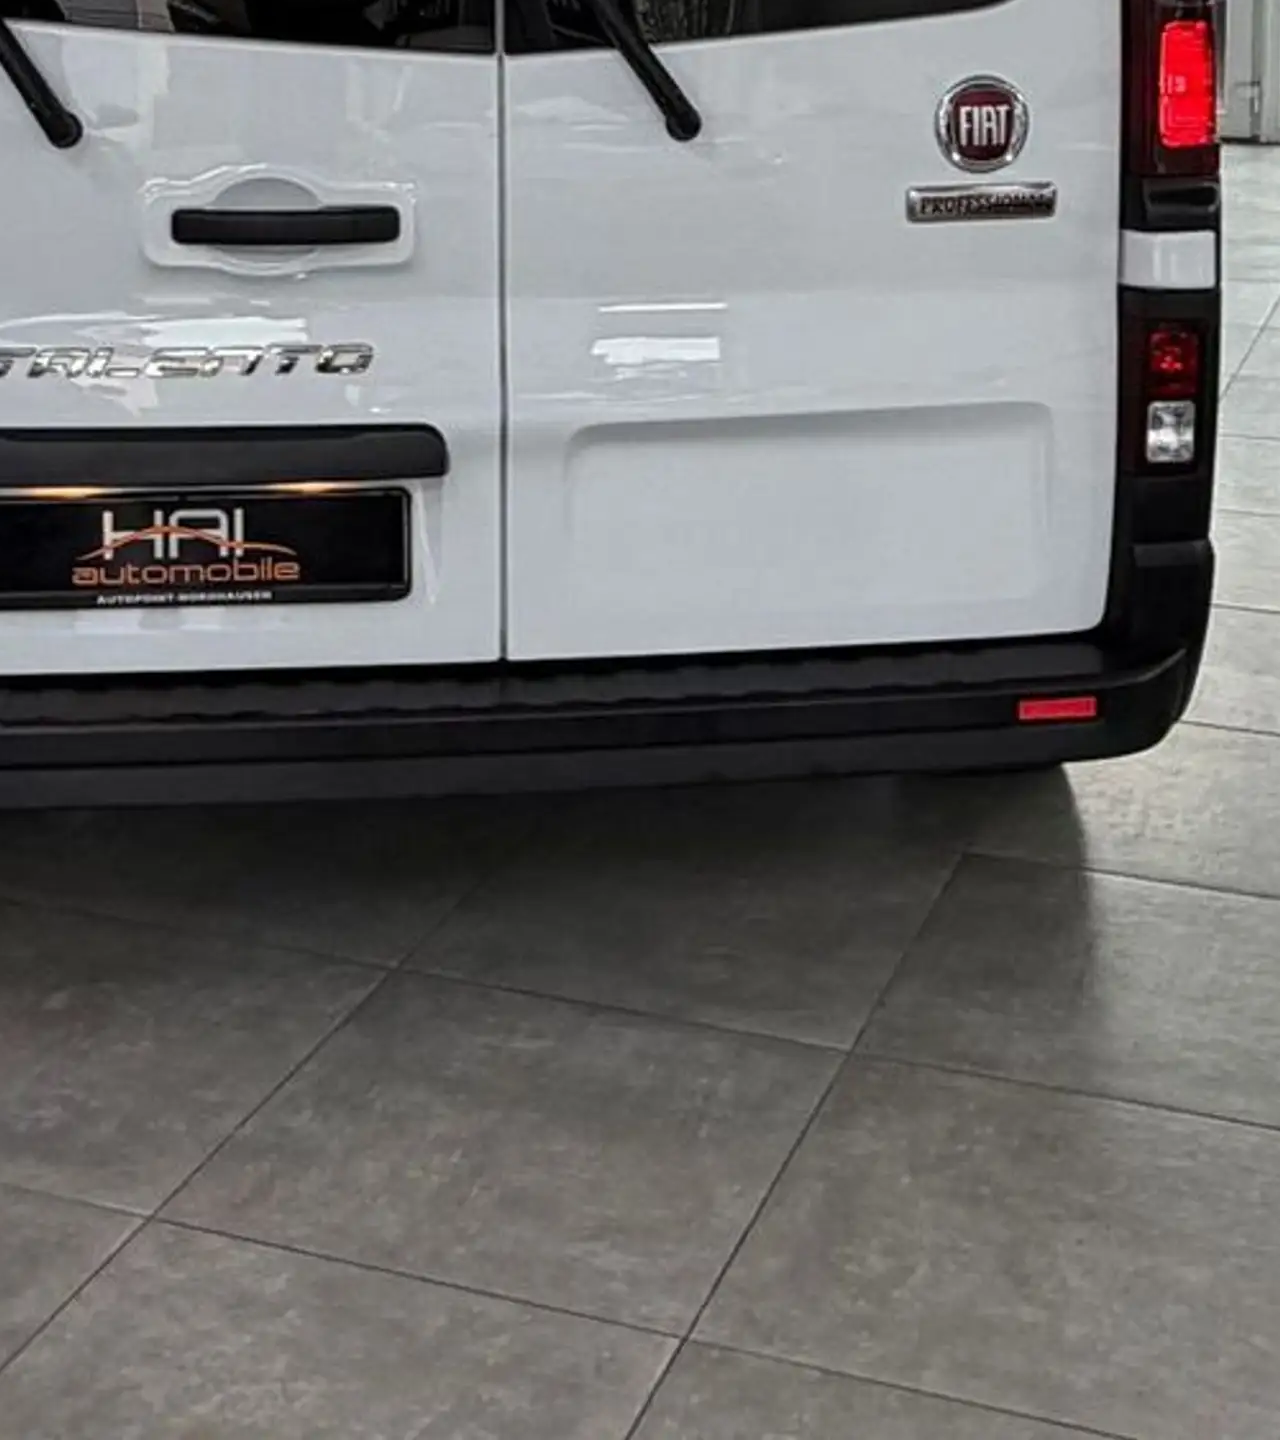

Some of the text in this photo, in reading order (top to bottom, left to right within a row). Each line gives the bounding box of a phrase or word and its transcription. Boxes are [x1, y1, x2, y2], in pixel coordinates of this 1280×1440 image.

[958, 103, 1012, 147] FIAT
[101, 507, 245, 560] HAI
[71, 557, 301, 586] automobile
